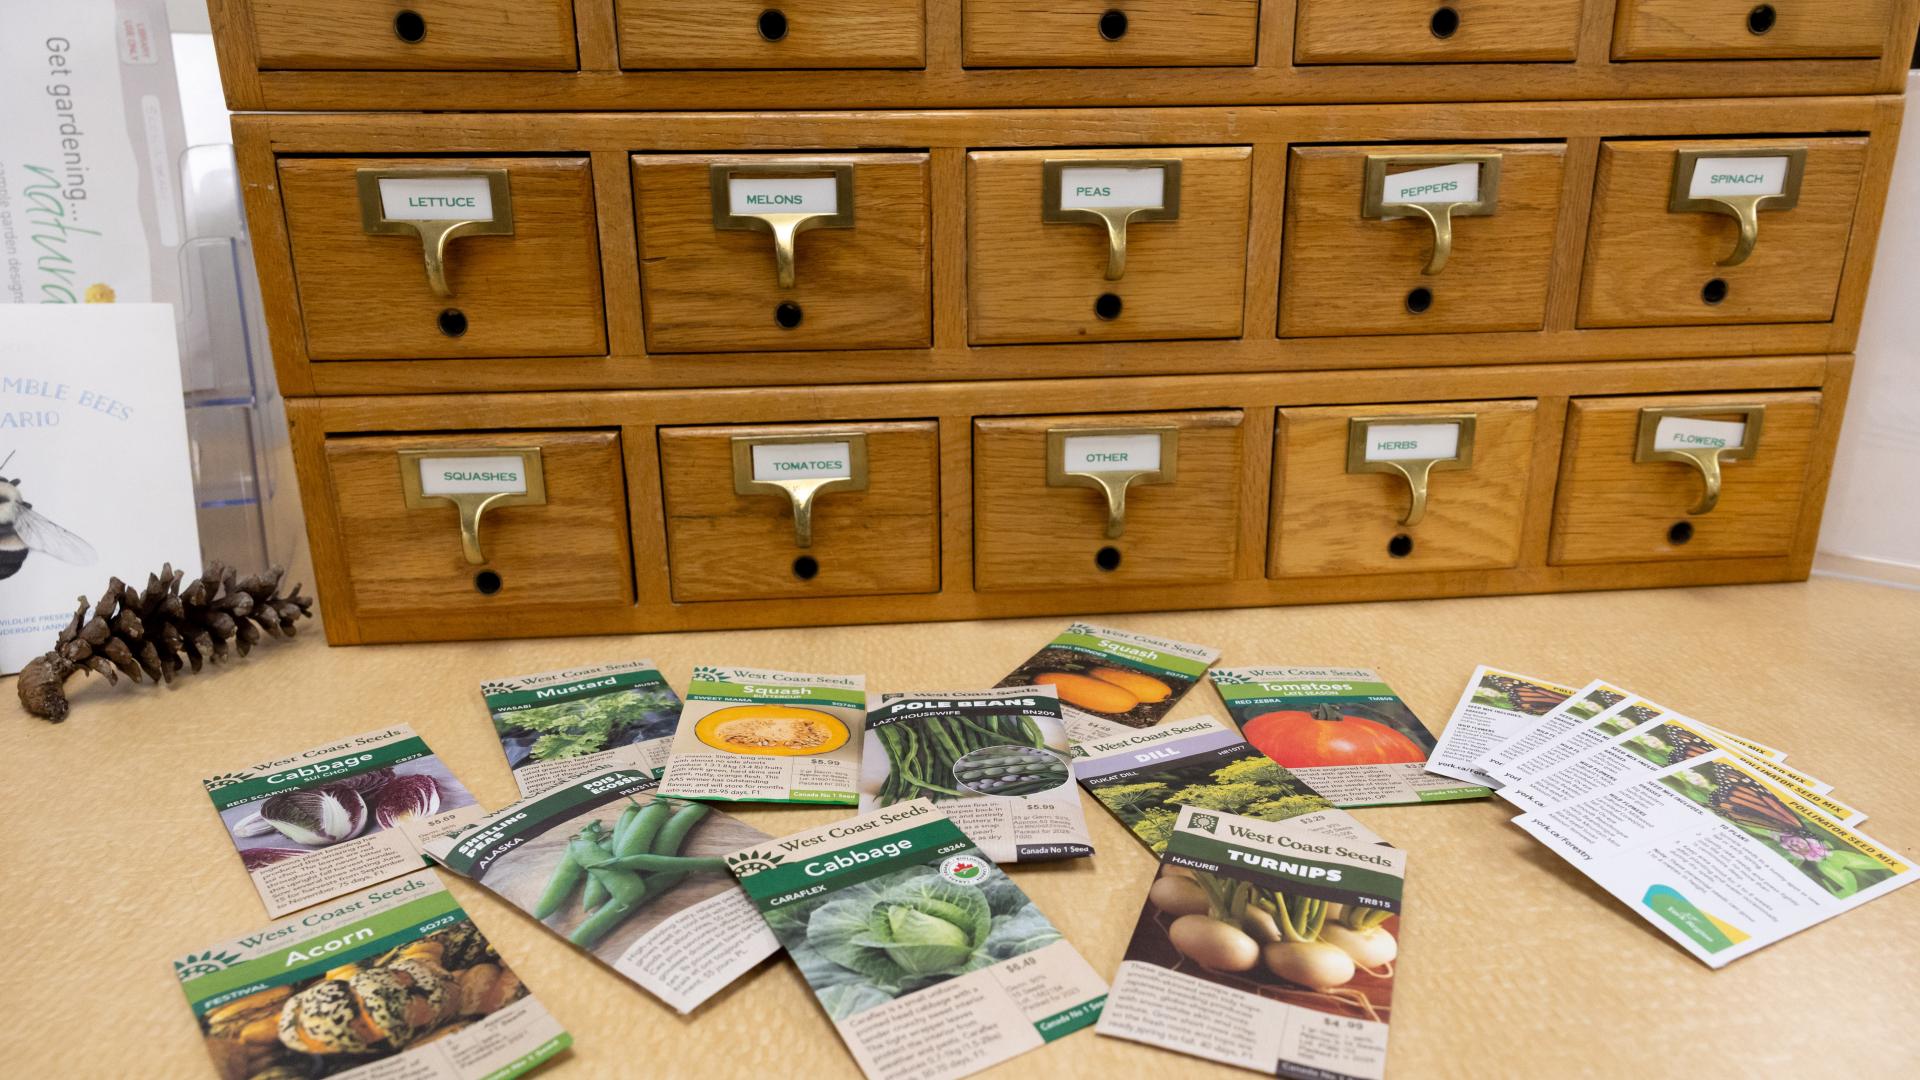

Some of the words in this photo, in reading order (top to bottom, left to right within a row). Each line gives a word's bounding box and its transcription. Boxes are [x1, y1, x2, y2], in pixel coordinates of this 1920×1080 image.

[46, 36, 71, 77] Get
[46, 84, 88, 222] gardening...
[1710, 174, 1763, 184] SPINACH
[1075, 187, 1111, 197] PEAS
[1400, 181, 1458, 198] PEPPERS
[408, 196, 476, 208] LETTUCE
[746, 194, 803, 206] MELONS
[77, 389, 134, 422] BEES
[0, 411, 60, 428] ARIO
[1377, 440, 1418, 450] HERBS
[1673, 433, 1726, 447] FLOWERS
[773, 460, 843, 471] TOMATOES
[1086, 452, 1128, 463] OTHER
[443, 471, 518, 482] SQUASHES
[1098, 639, 1158, 661] Squash
[1102, 629, 1129, 639] West
[1134, 635, 1168, 648] Coast
[1172, 644, 1208, 657] Seeds
[521, 676, 559, 685] West
[562, 667, 601, 678] Coast
[606, 662, 644, 670] Seeds
[734, 670, 767, 680] West
[772, 674, 811, 682] Coast
[817, 677, 855, 686] Seeds
[1330, 669, 1370, 677] Seeds
[536, 677, 616, 699] Mustard
[743, 686, 812, 696] Squash
[997, 687, 1039, 695] Seeds
[1258, 683, 1353, 692] Tomatoes
[498, 704, 532, 712] WASABI
[891, 701, 951, 713] POLE
[957, 699, 1036, 707] BEANS
[872, 716, 898, 727] LAZY
[900, 710, 961, 720] HOUSEWIFE
[1022, 709, 1055, 717] BN209
[1093, 740, 1128, 754] West
[1130, 731, 1174, 745] Coast
[1175, 721, 1213, 736] Seeds
[253, 756, 299, 772] West
[302, 742, 353, 760] Coast
[354, 729, 401, 747] Seeds
[1134, 746, 1181, 763] DILL
[1748, 744, 1766, 755] MIX
[267, 753, 374, 785] Cabbage
[810, 758, 840, 766] $5.99
[226, 798, 248, 809] RED
[250, 786, 300, 802] SCARVITA
[394, 752, 422, 765] CB275
[303, 775, 321, 784] SUI
[322, 767, 350, 779] CHOI
[1089, 773, 1119, 786] DUKAT
[1120, 770, 1139, 782] DILL
[1594, 767, 1617, 781] FLOWERS
[1787, 773, 1806, 784] MIX
[583, 776, 615, 791] POIS
[1740, 757, 1799, 791] POLLINATOR
[1794, 787, 1822, 802] SEED
[1822, 800, 1842, 814] MIX
[427, 814, 456, 828] $5.69
[777, 834, 825, 853] West
[828, 820, 879, 840] Coast
[880, 805, 929, 826] Seeds
[459, 812, 528, 854] SHELLING
[1532, 817, 1593, 861] york.ca/Forestry
[1789, 801, 1847, 838] POLLINATOR
[1847, 835, 1880, 857] SEED
[1876, 852, 1898, 868] MIX
[466, 832, 505, 858] PEAS
[480, 837, 525, 869] ALASKA
[1021, 847, 1048, 855] Canada
[1228, 823, 1274, 845] West
[1277, 836, 1330, 856] Coast
[1335, 847, 1392, 868] Seeds
[804, 838, 913, 877] Cabbage
[1227, 849, 1343, 882] TURNIPS
[770, 884, 827, 906] CARAFLEX
[937, 841, 966, 855] CB246
[1171, 856, 1219, 871] HAKUREI
[1357, 896, 1391, 909] TR815
[237, 923, 296, 950] West
[301, 901, 366, 928] Coast
[367, 878, 427, 907] Seeds
[284, 925, 376, 968] Acorn
[203, 982, 269, 1008] FESTIVAL
[419, 915, 455, 933] SQ723
[1005, 956, 1037, 974] $6.49
[1040, 1014, 1070, 1031] Canada
